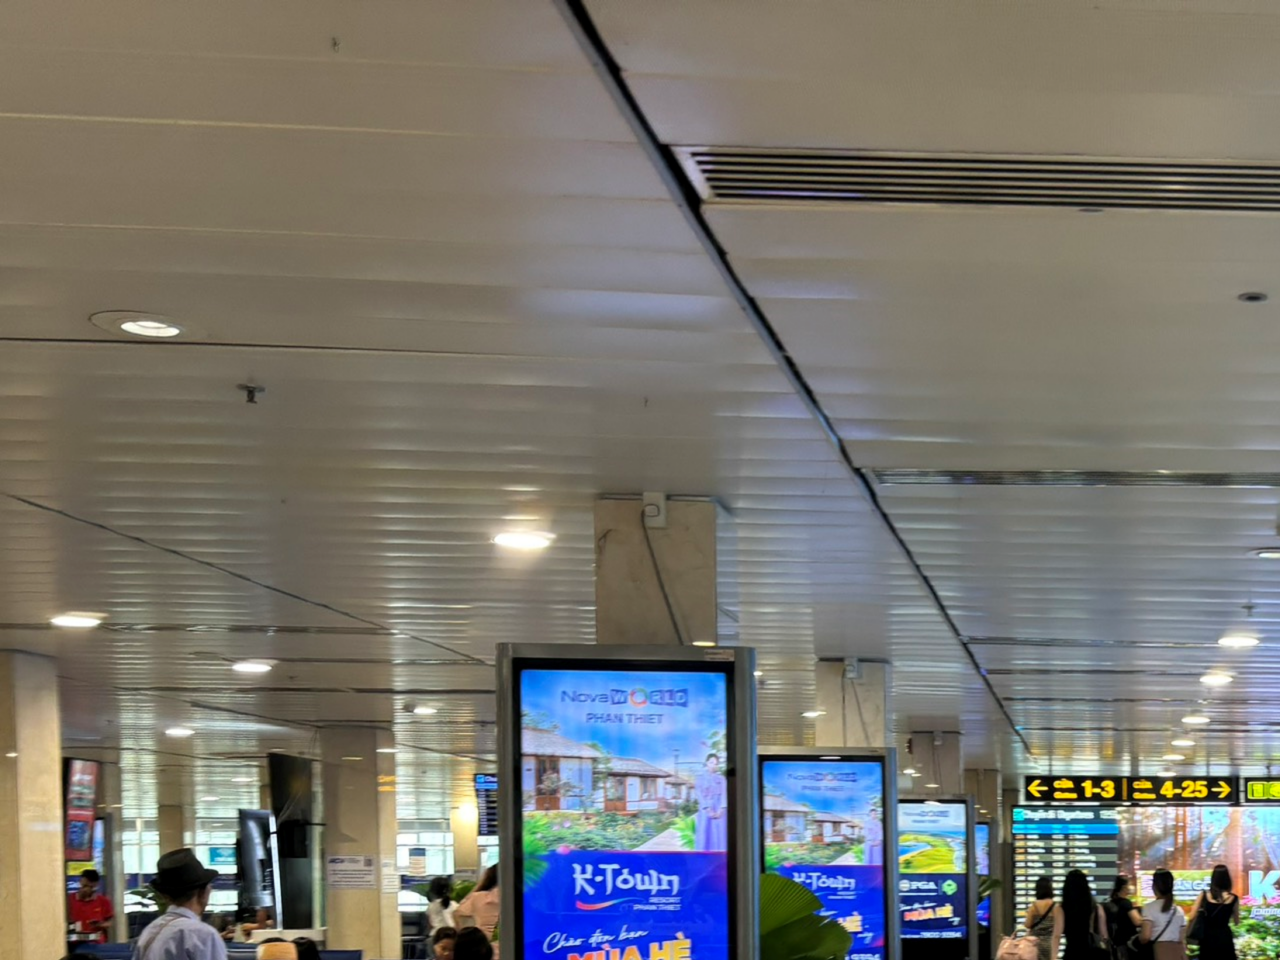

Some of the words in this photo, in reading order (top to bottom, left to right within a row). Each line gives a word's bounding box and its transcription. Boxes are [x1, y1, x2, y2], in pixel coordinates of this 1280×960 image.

[586, 712, 624, 724] PHAN
[1081, 780, 1116, 798] 1-3
[1160, 780, 1208, 798] 4-25
